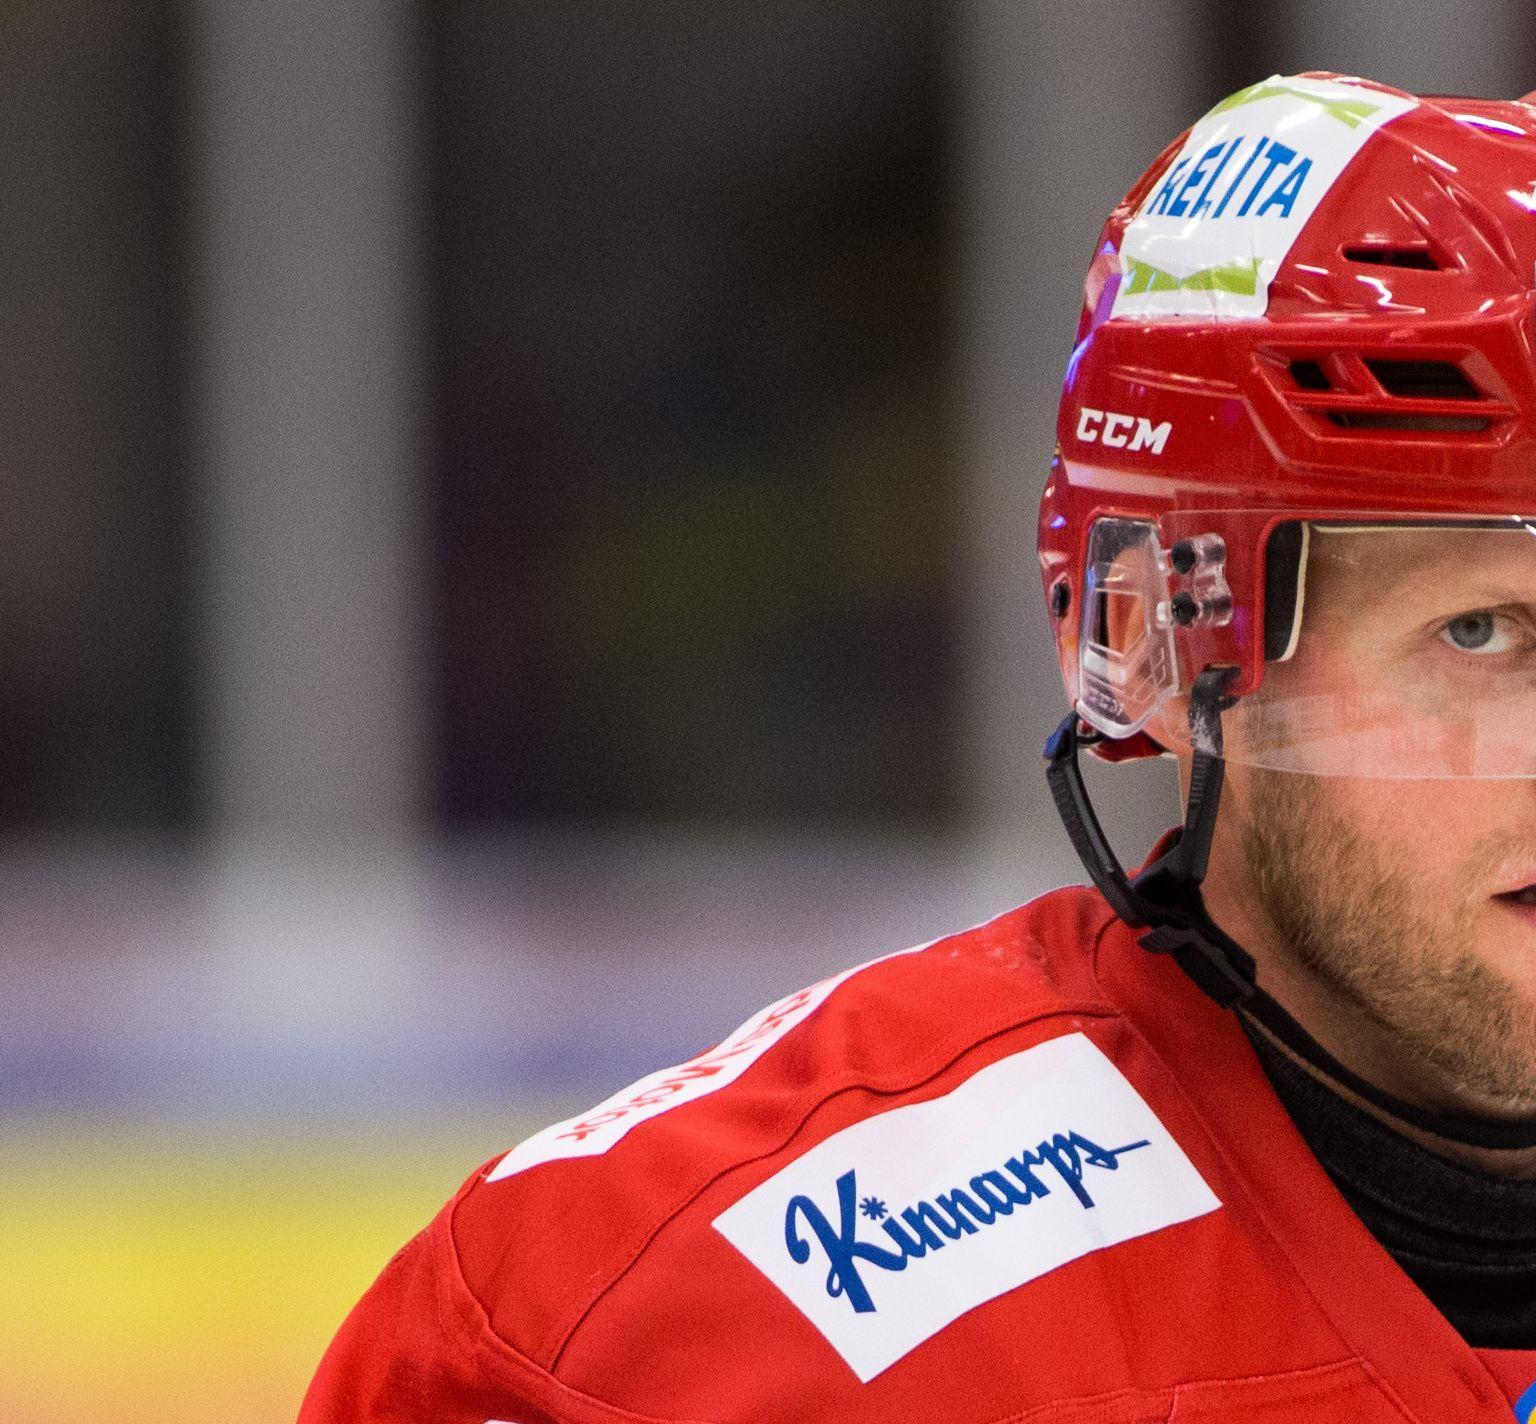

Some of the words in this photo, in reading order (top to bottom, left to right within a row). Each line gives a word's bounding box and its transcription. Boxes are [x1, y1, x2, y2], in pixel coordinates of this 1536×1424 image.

[1147, 135, 1313, 219] RELITA
[1076, 407, 1172, 455] CCM
[784, 1128, 1152, 1313] Kinnarps
